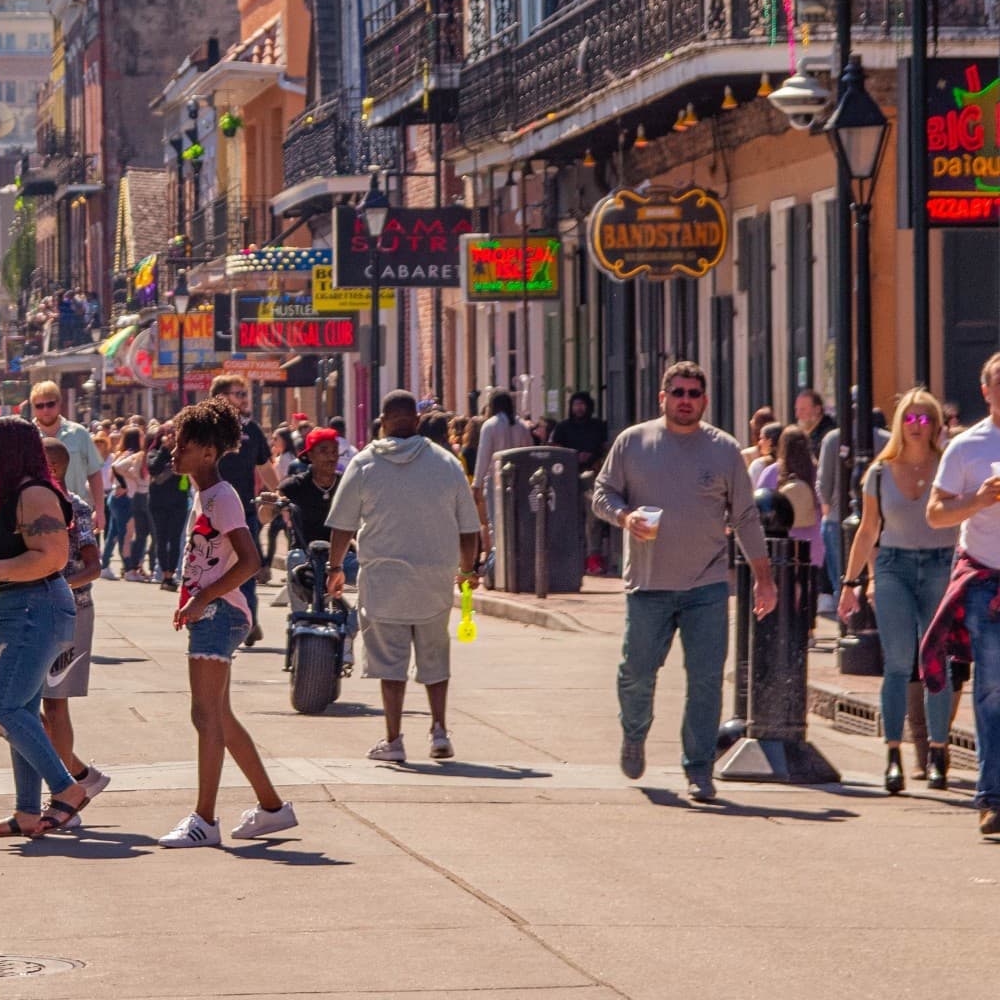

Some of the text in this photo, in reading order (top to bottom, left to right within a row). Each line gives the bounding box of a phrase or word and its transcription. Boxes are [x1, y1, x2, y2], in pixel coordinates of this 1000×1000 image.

[927, 104, 985, 151] BIG
[350, 235, 460, 252] SUTR
[602, 220, 720, 249] BANDSTAND
[324, 320, 354, 347] CLUB
